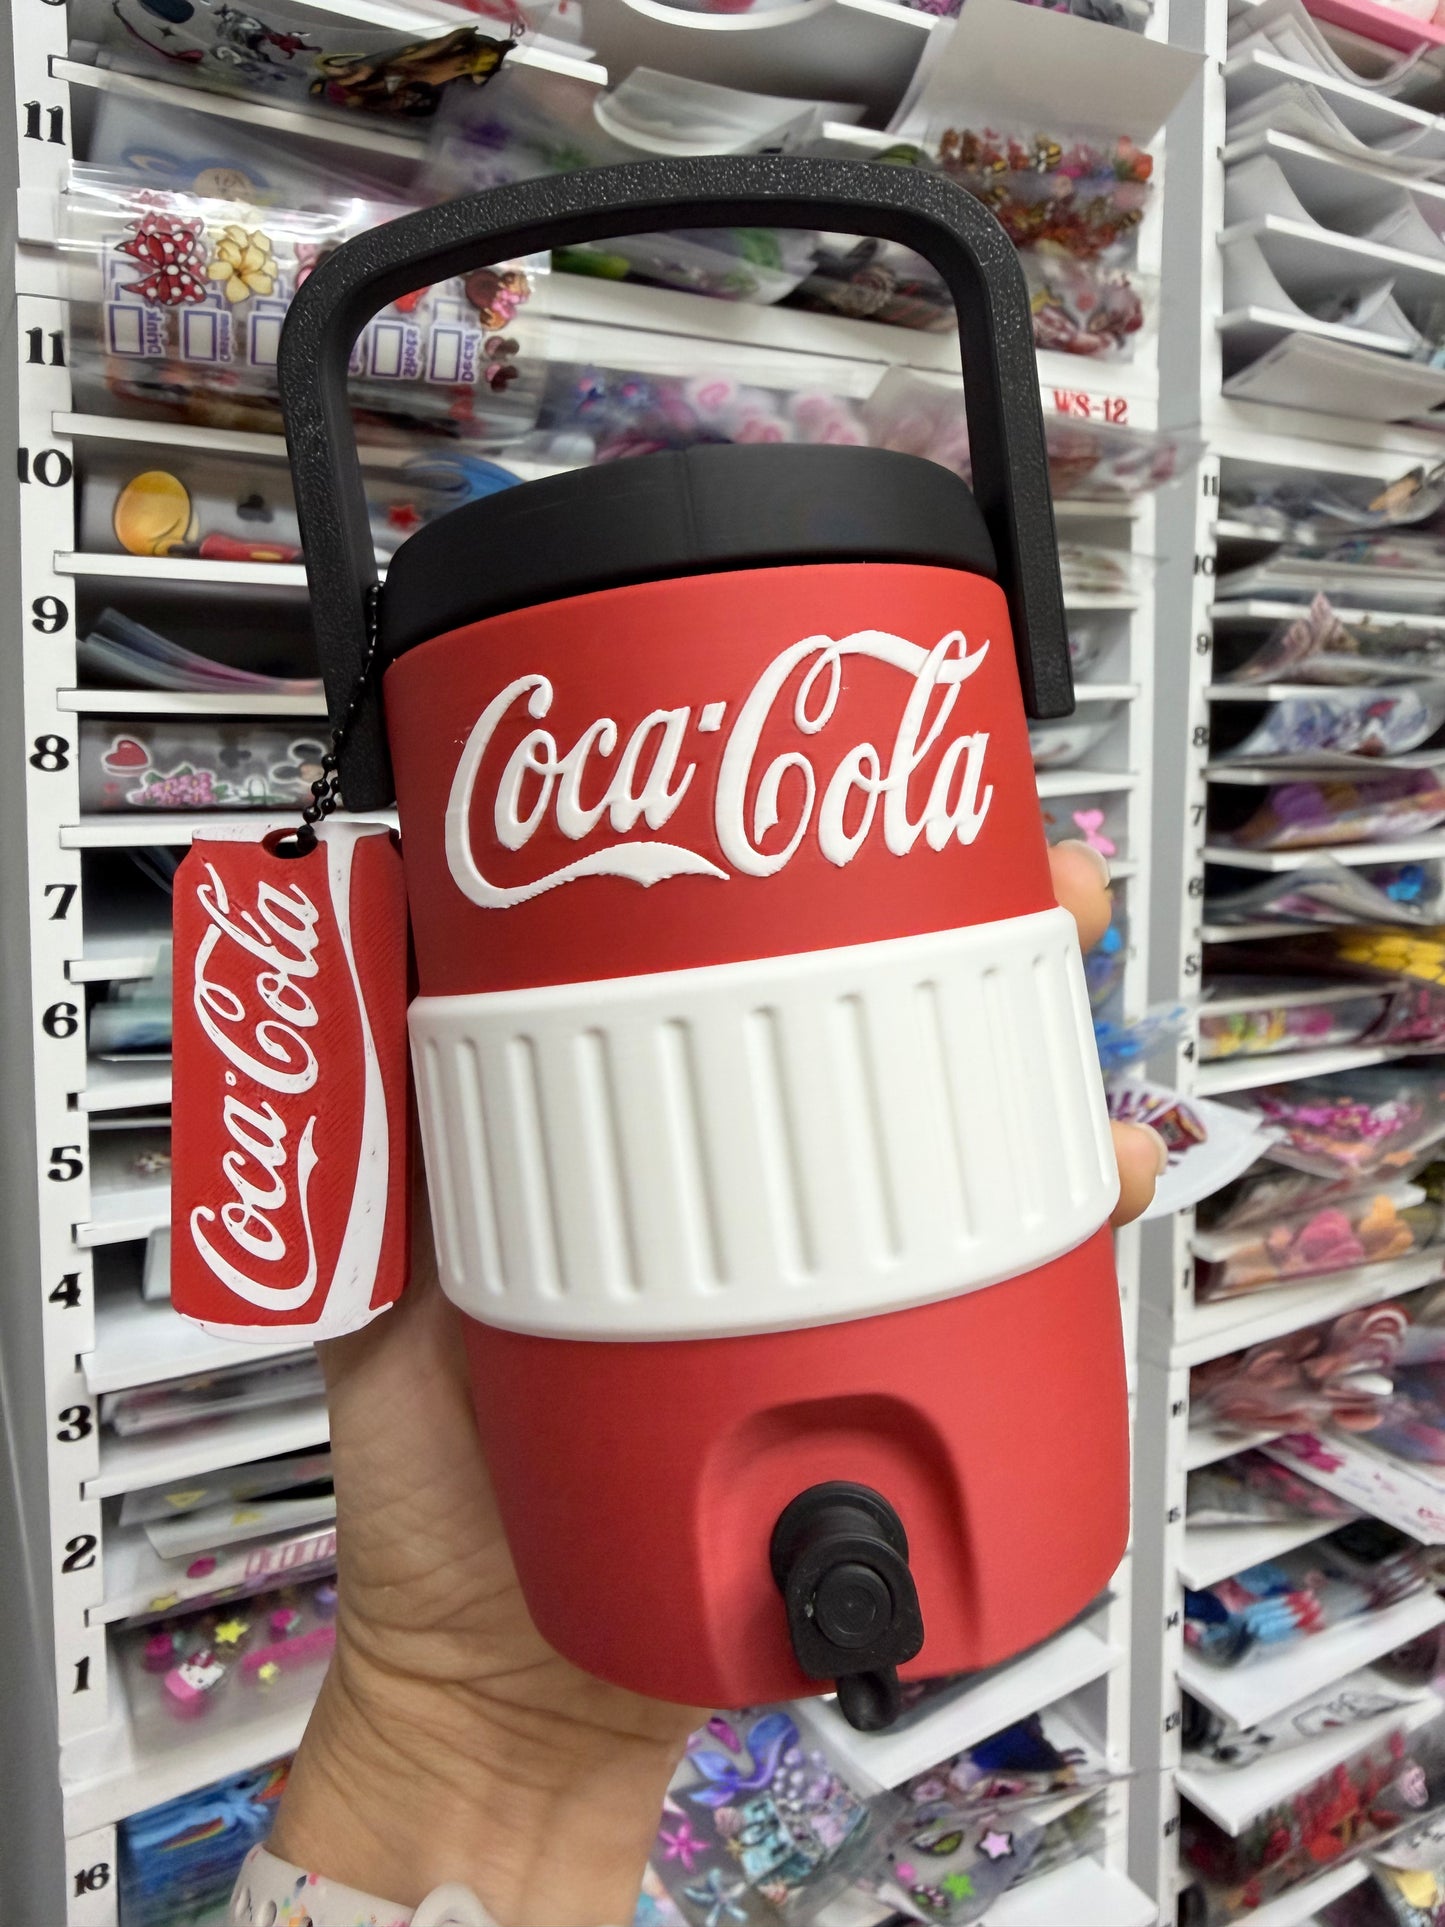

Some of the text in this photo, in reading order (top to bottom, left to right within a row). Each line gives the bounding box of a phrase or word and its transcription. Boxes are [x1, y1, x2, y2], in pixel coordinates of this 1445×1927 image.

[23, 100, 66, 146] 11
[25, 327, 67, 368] 11
[1053, 389, 1128, 425] WS-12
[16, 446, 74, 488] 10
[32, 595, 69, 634] 9
[29, 734, 70, 772] 8
[444, 629, 994, 910] Coca-Cola
[1190, 804, 1206, 827] 7
[44, 884, 78, 920] 7
[42, 1002, 79, 1039] 6
[190, 862, 320, 1312] Coca-Cola
[47, 1145, 84, 1182] 5
[48, 1272, 81, 1310] 4
[56, 1404, 93, 1443] 3
[61, 1534, 97, 1574] 2
[72, 1656, 92, 1694] 1
[73, 1862, 110, 1898] 16
